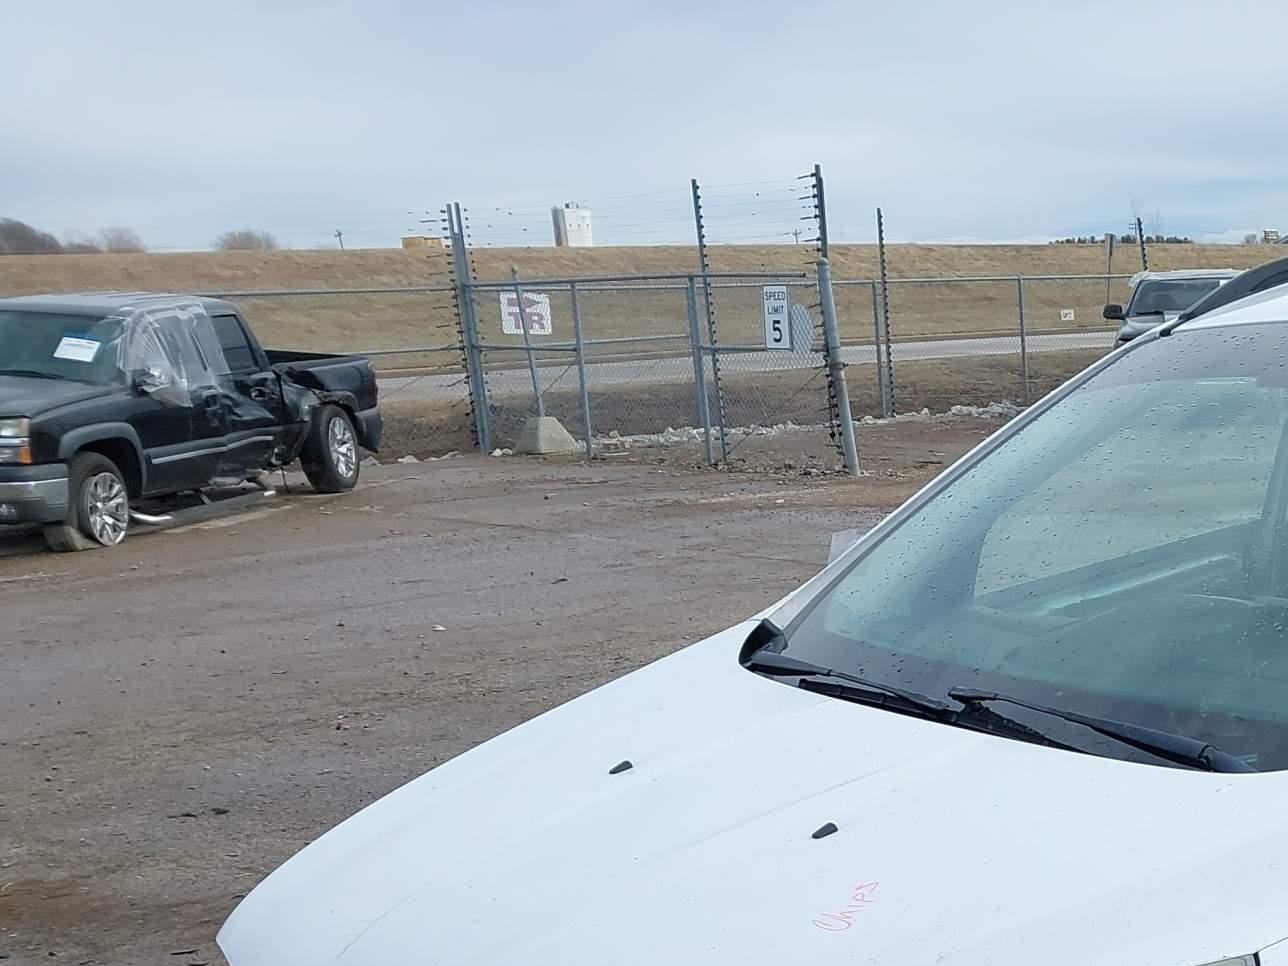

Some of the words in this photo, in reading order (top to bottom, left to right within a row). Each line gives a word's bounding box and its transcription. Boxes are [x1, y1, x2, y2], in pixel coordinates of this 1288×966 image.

[765, 291, 785, 301] SPEED
[768, 305, 784, 315] LIMIT
[773, 319, 782, 343] 5
